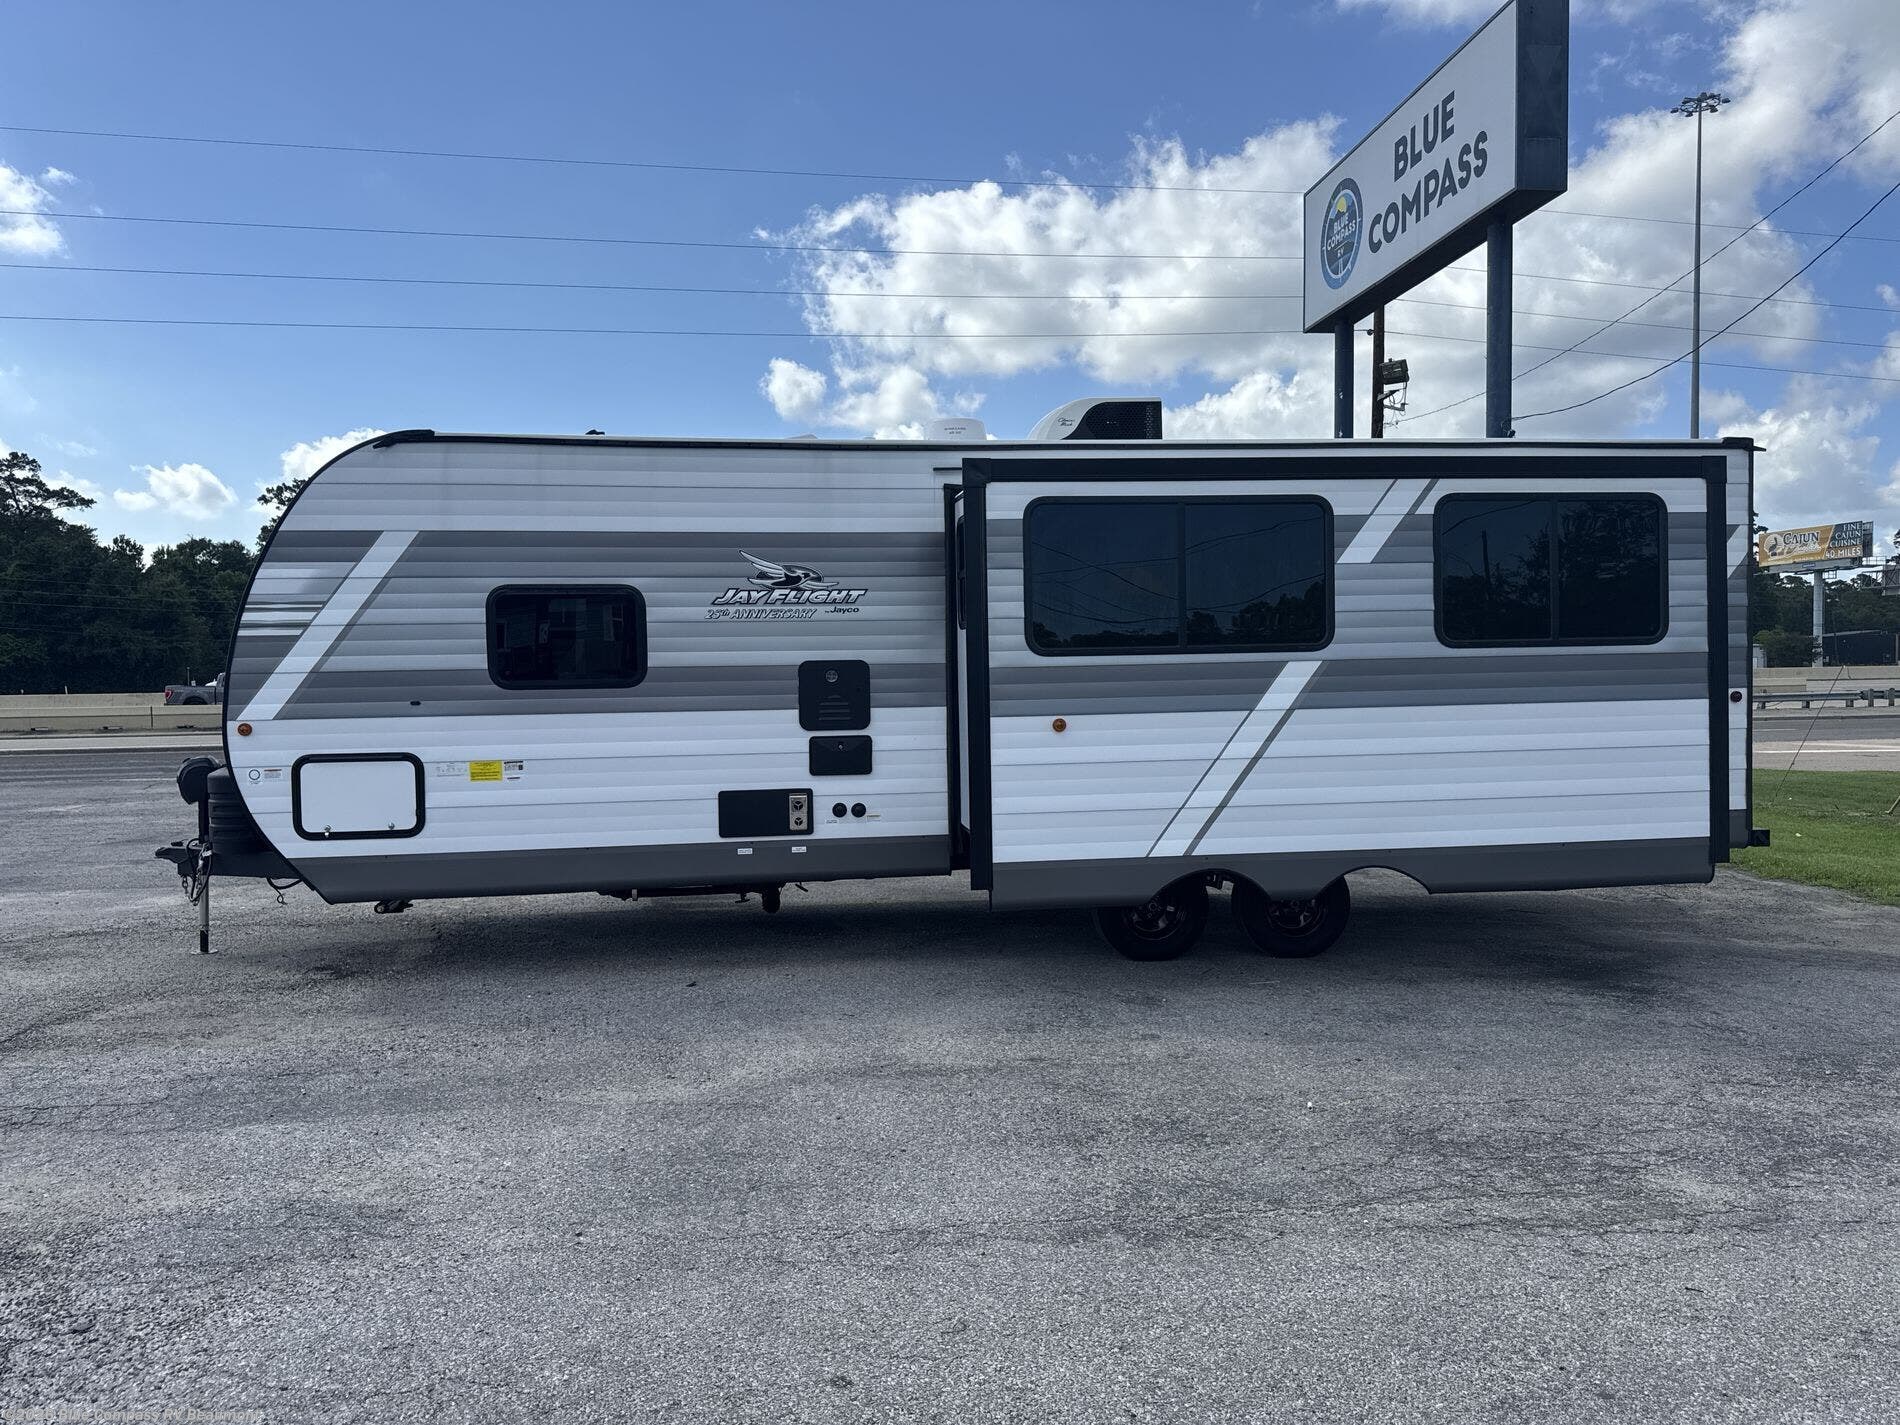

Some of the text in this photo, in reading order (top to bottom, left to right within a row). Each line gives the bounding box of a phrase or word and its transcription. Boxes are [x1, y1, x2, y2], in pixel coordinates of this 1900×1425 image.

[1394, 90, 1455, 183] BLUE
[1368, 130, 1488, 254] COMPASS
[1333, 212, 1349, 235] BLUE
[1327, 219, 1356, 251] COMPASS
[1843, 522, 1862, 531] FINE
[1783, 531, 1820, 546] CAJUN
[1835, 530, 1861, 540] CAJUN
[1829, 538, 1862, 548] CUISINE
[1825, 549, 1836, 559] 40
[1837, 547, 1861, 558] MILES
[711, 588, 868, 606] JAY FLIGHT
[704, 608, 817, 620] 25th ANNIVERSARY
[830, 606, 860, 614] Jayco
